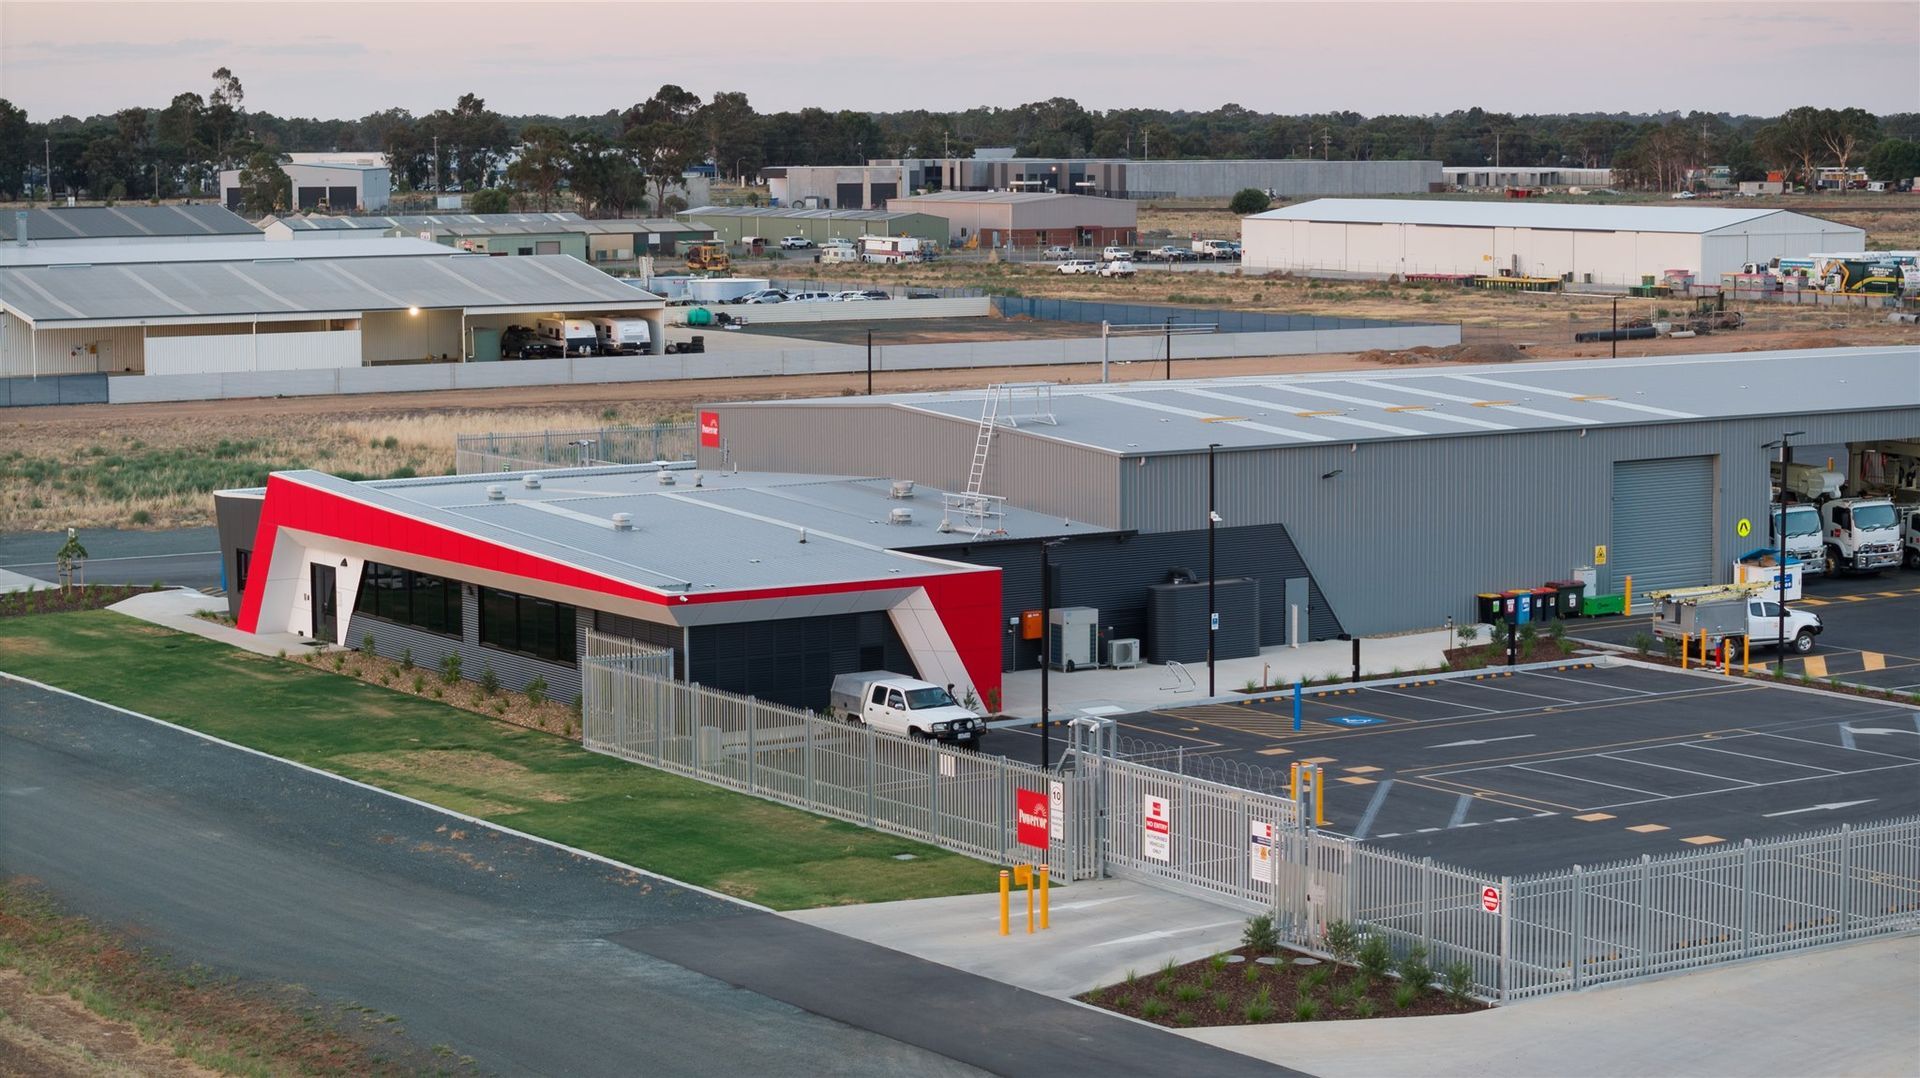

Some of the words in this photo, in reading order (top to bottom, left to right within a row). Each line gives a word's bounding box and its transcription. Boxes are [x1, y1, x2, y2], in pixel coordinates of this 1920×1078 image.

[1053, 792, 1061, 801] 10
[1019, 809, 1047, 829] Powercor
[1146, 820, 1154, 828] NO
[1154, 822, 1168, 831] ENTRY
